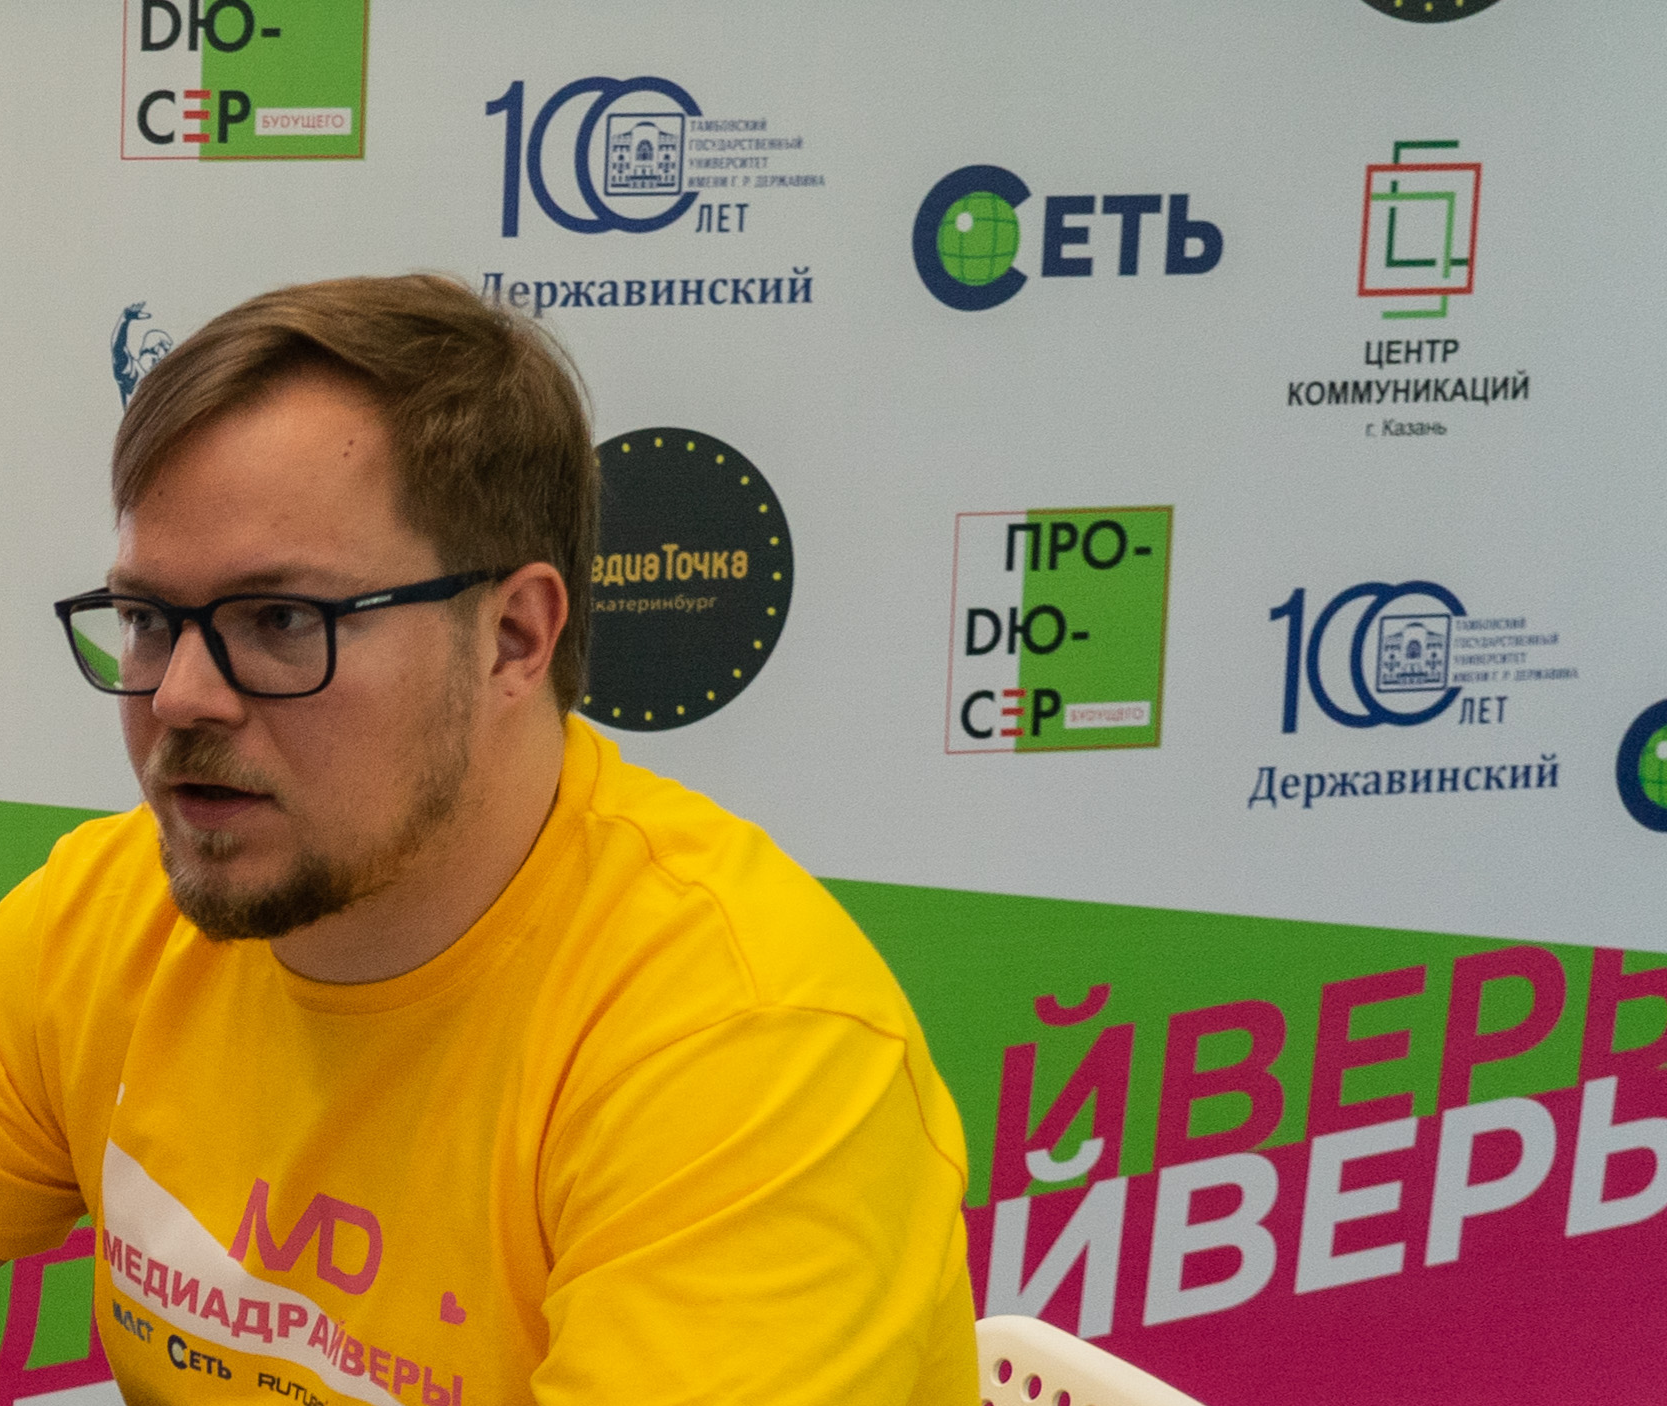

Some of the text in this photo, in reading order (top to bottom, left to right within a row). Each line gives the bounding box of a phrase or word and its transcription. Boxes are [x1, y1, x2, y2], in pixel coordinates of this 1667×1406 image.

[695, 204, 749, 234] ЛЕТ
[911, 164, 1224, 312] СЕТЬ
[1364, 339, 1459, 369] ЦЕНТР
[1287, 370, 1529, 407] КОММУНИКАЦИЙ
[1382, 418, 1447, 437] Казань
[1005, 519, 1153, 571] ПРО-
[1458, 696, 1508, 725] ЛЕТ
[1247, 754, 1560, 809] Державинский
[167, 1334, 232, 1380] СЕТЬ
